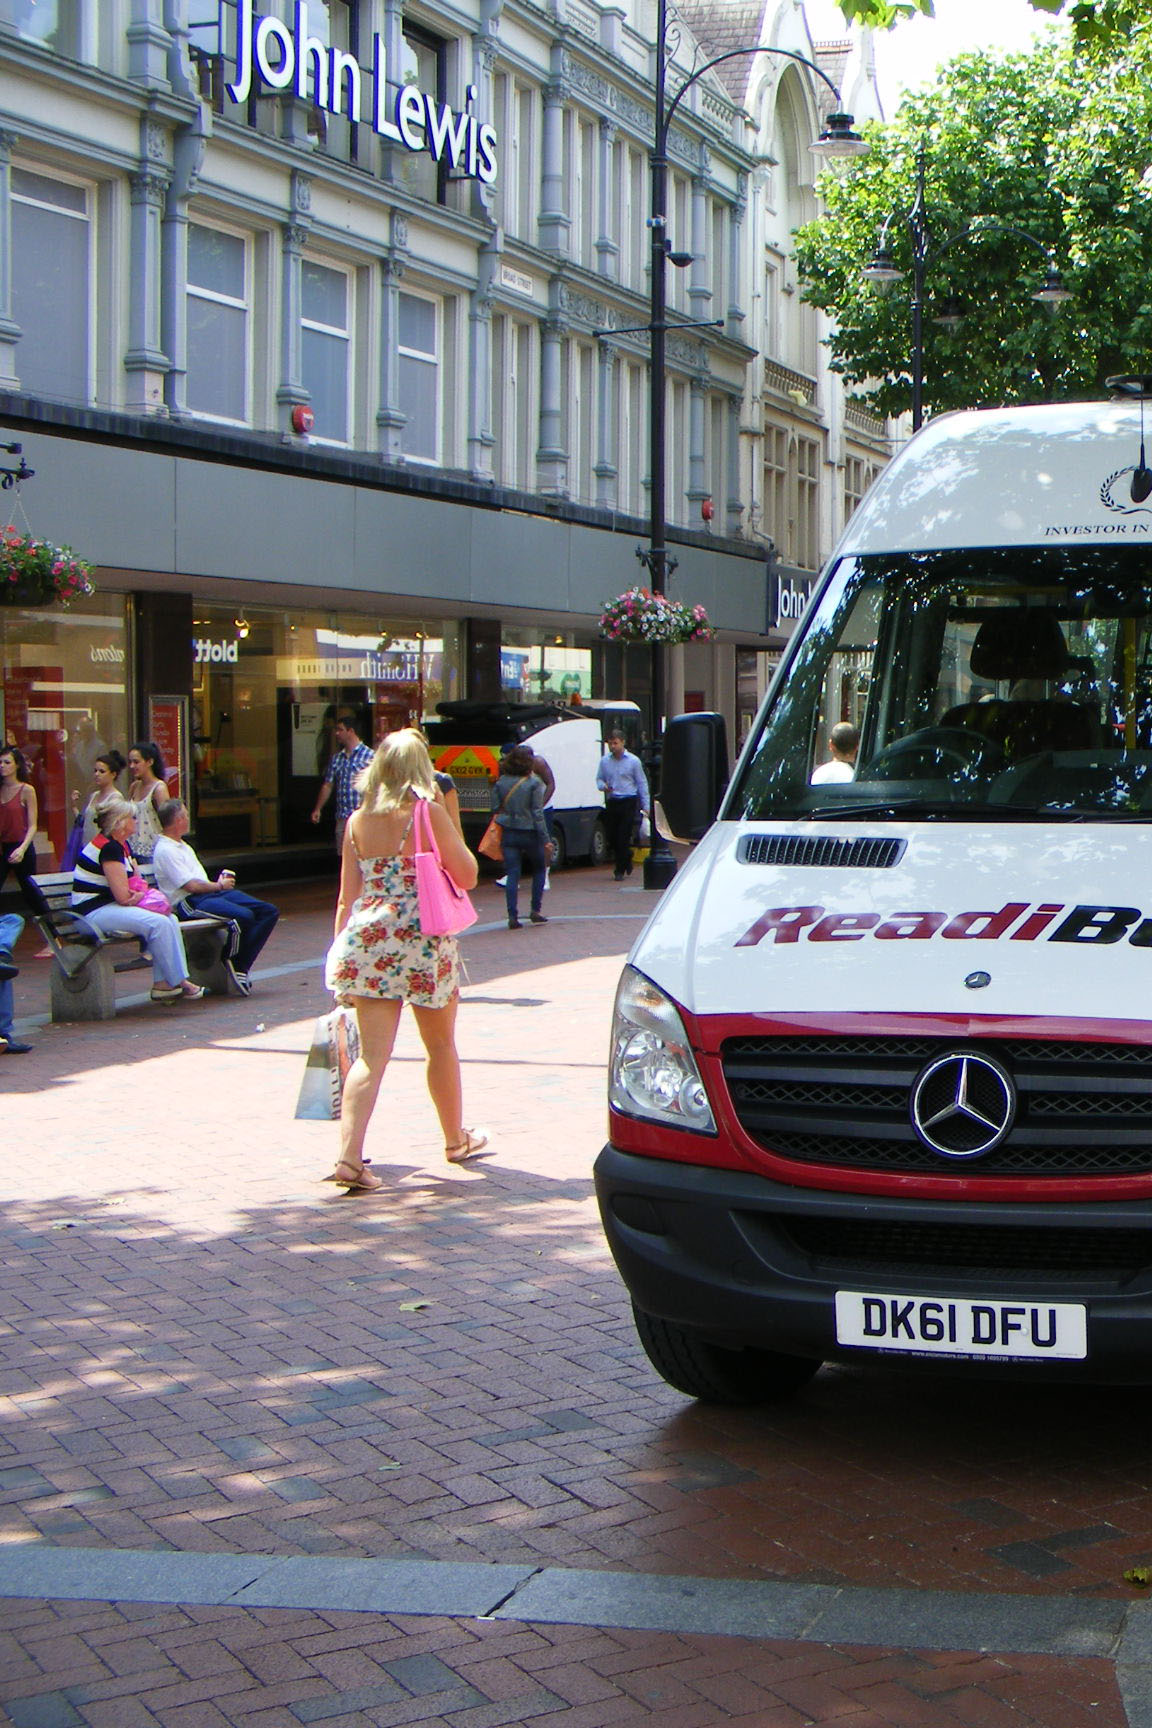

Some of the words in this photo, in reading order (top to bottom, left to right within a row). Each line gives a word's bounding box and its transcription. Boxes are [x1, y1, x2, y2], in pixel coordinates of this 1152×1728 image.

[224, 0, 361, 124] John
[373, 32, 498, 185] Lewis
[1044, 525, 1128, 537] INVESTOR
[1132, 524, 1150, 534] IN
[862, 1297, 957, 1343] DK61
[971, 1304, 1058, 1348] DFU
